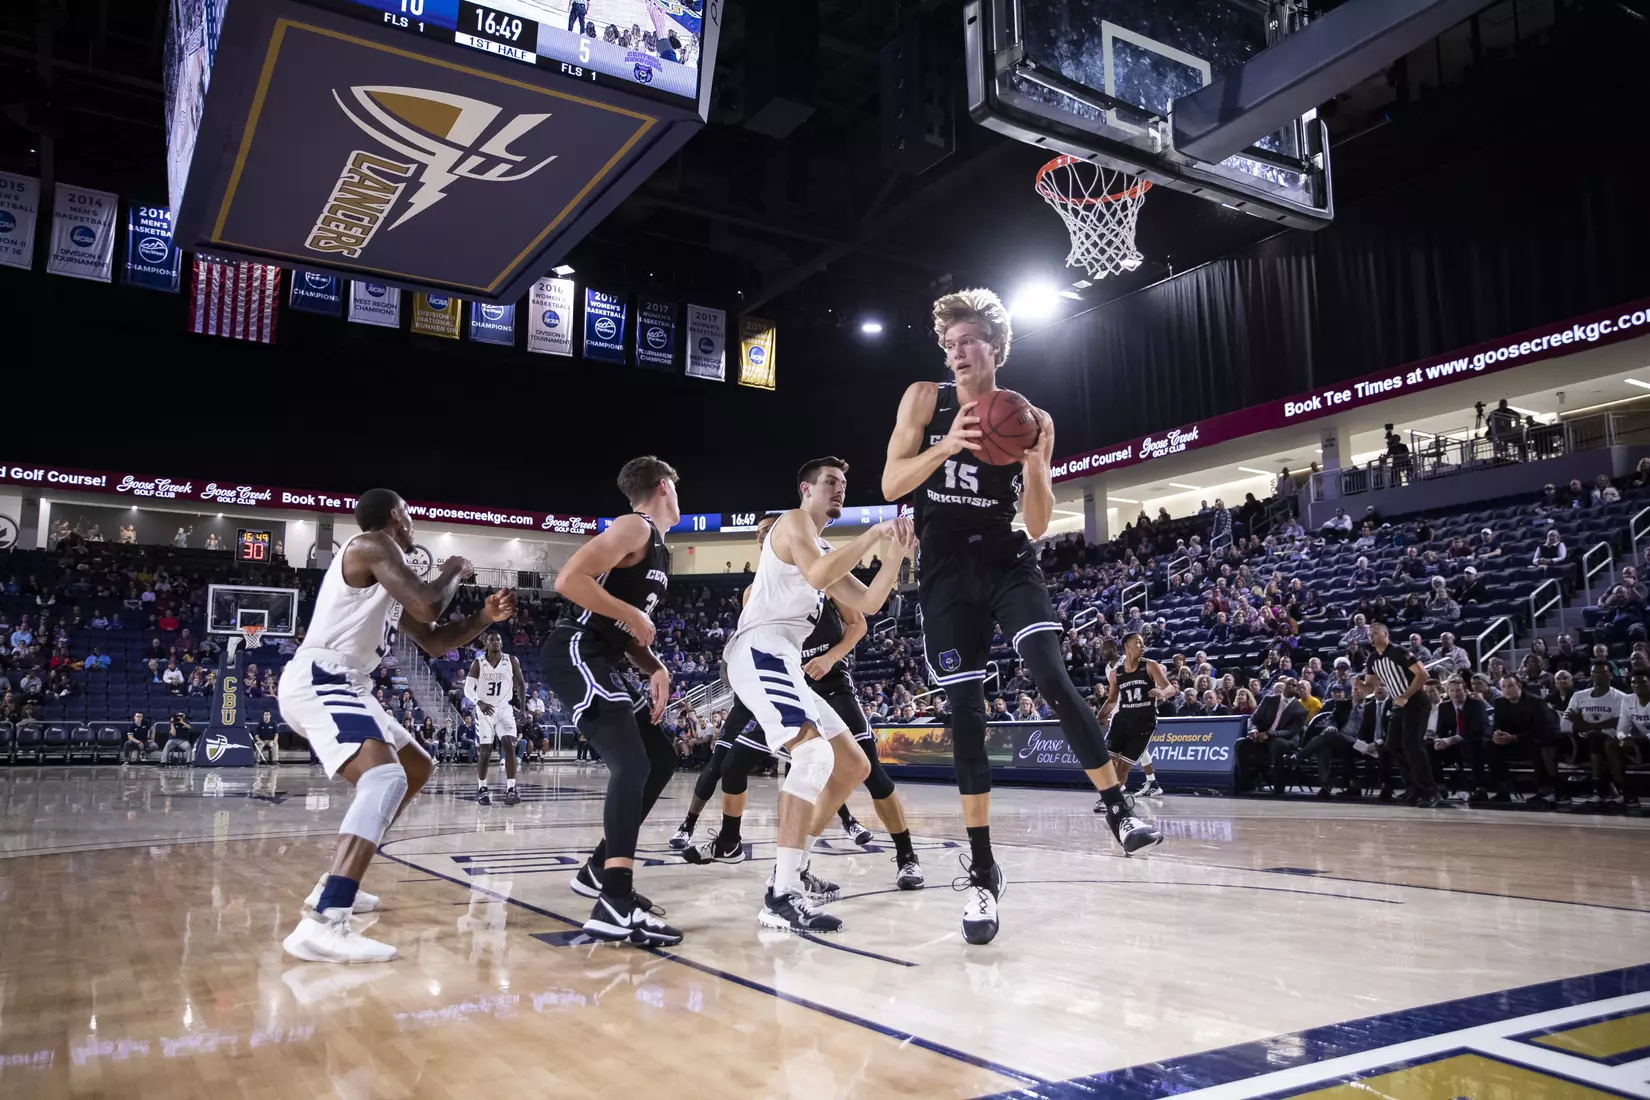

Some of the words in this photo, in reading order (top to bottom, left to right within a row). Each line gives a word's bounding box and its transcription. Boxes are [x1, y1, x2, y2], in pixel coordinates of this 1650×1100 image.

[384, 12, 409, 28] FLS
[418, 22, 425, 33] 1
[476, 8, 523, 41] 16:49
[470, 37, 492, 50] 1ST
[498, 45, 527, 60] HALF
[580, 38, 591, 63] 5
[561, 63, 582, 77] FLS
[591, 72, 596, 81] 1
[0, 193, 20, 201] EN'S
[68, 193, 103, 207] 2014
[304, 150, 418, 258] LANCERS
[0, 202, 34, 213] ETBALL
[69, 206, 98, 216] MEN'S
[139, 207, 171, 220] 2014
[55, 212, 112, 227] BASKETBALL
[141, 218, 168, 229] MEN'S
[129, 224, 171, 238] BASKETBA
[52, 254, 109, 268] TOURNAMENT
[60, 248, 96, 260] DIVISION
[125, 262, 177, 277] CHAMPIONS
[293, 288, 340, 301] CHAMPIONS
[540, 283, 563, 294] 2016
[372, 300, 398, 309] REGION
[429, 297, 448, 306] NCAA
[532, 299, 571, 310] BASKETBALL
[594, 292, 619, 303] 2017
[354, 304, 395, 316] CHAMPIONS
[587, 306, 625, 320] BASKETBALL
[590, 300, 621, 312] WOMEN'S
[646, 302, 669, 313] 2017
[417, 309, 450, 320] DIVISION
[696, 312, 717, 323] 2017
[415, 322, 445, 332] RUNNER
[418, 317, 454, 327] NATIONAL
[471, 321, 512, 332] CHAMPIONS
[531, 335, 570, 345] TOURNAMENT
[536, 330, 561, 338] DIVISION
[586, 339, 624, 351] CHAMPIONS
[640, 355, 672, 365] CHAMPIONS
[1284, 396, 1322, 417] Book
[1324, 390, 1352, 407] Tee
[1354, 376, 1403, 399] Times
[1406, 367, 1423, 385] at
[1139, 437, 1169, 459] Goose
[1167, 426, 1199, 446] Creek
[1152, 448, 1170, 458] GOLF
[1169, 443, 1186, 454] CLUB
[1050, 463, 1067, 479] ted
[1069, 457, 1090, 473] Golf
[1091, 446, 1132, 467] Course!
[11, 467, 45, 481] Golf
[47, 470, 106, 487] Course!
[116, 475, 155, 492] Goose
[155, 478, 193, 493] Creek
[944, 460, 979, 494] 15
[134, 488, 155, 496] GOLF
[155, 490, 176, 498] CLUB
[201, 483, 237, 500] Goose
[236, 486, 272, 501] Creek
[237, 498, 256, 506] CLUB
[282, 492, 315, 506] Book
[318, 495, 341, 508] Tee
[407, 505, 533, 526] ww.goosecreekgc.com
[899, 504, 915, 518] Goo
[542, 514, 570, 529] Goose
[569, 517, 597, 530] Creek
[693, 515, 706, 531] 10
[731, 513, 756, 526] 16:49
[243, 542, 264, 560] 30
[486, 681, 502, 696] 31
[1126, 687, 1142, 703] 14
[221, 676, 237, 725] CBU
[1019, 730, 1064, 759] Goose
[1166, 732, 1201, 744] Sponsor
[1202, 732, 1213, 742] of
[1037, 753, 1060, 763] GOLF
[1061, 753, 1080, 764] CLU
[1151, 746, 1229, 761] ATHLETICS
